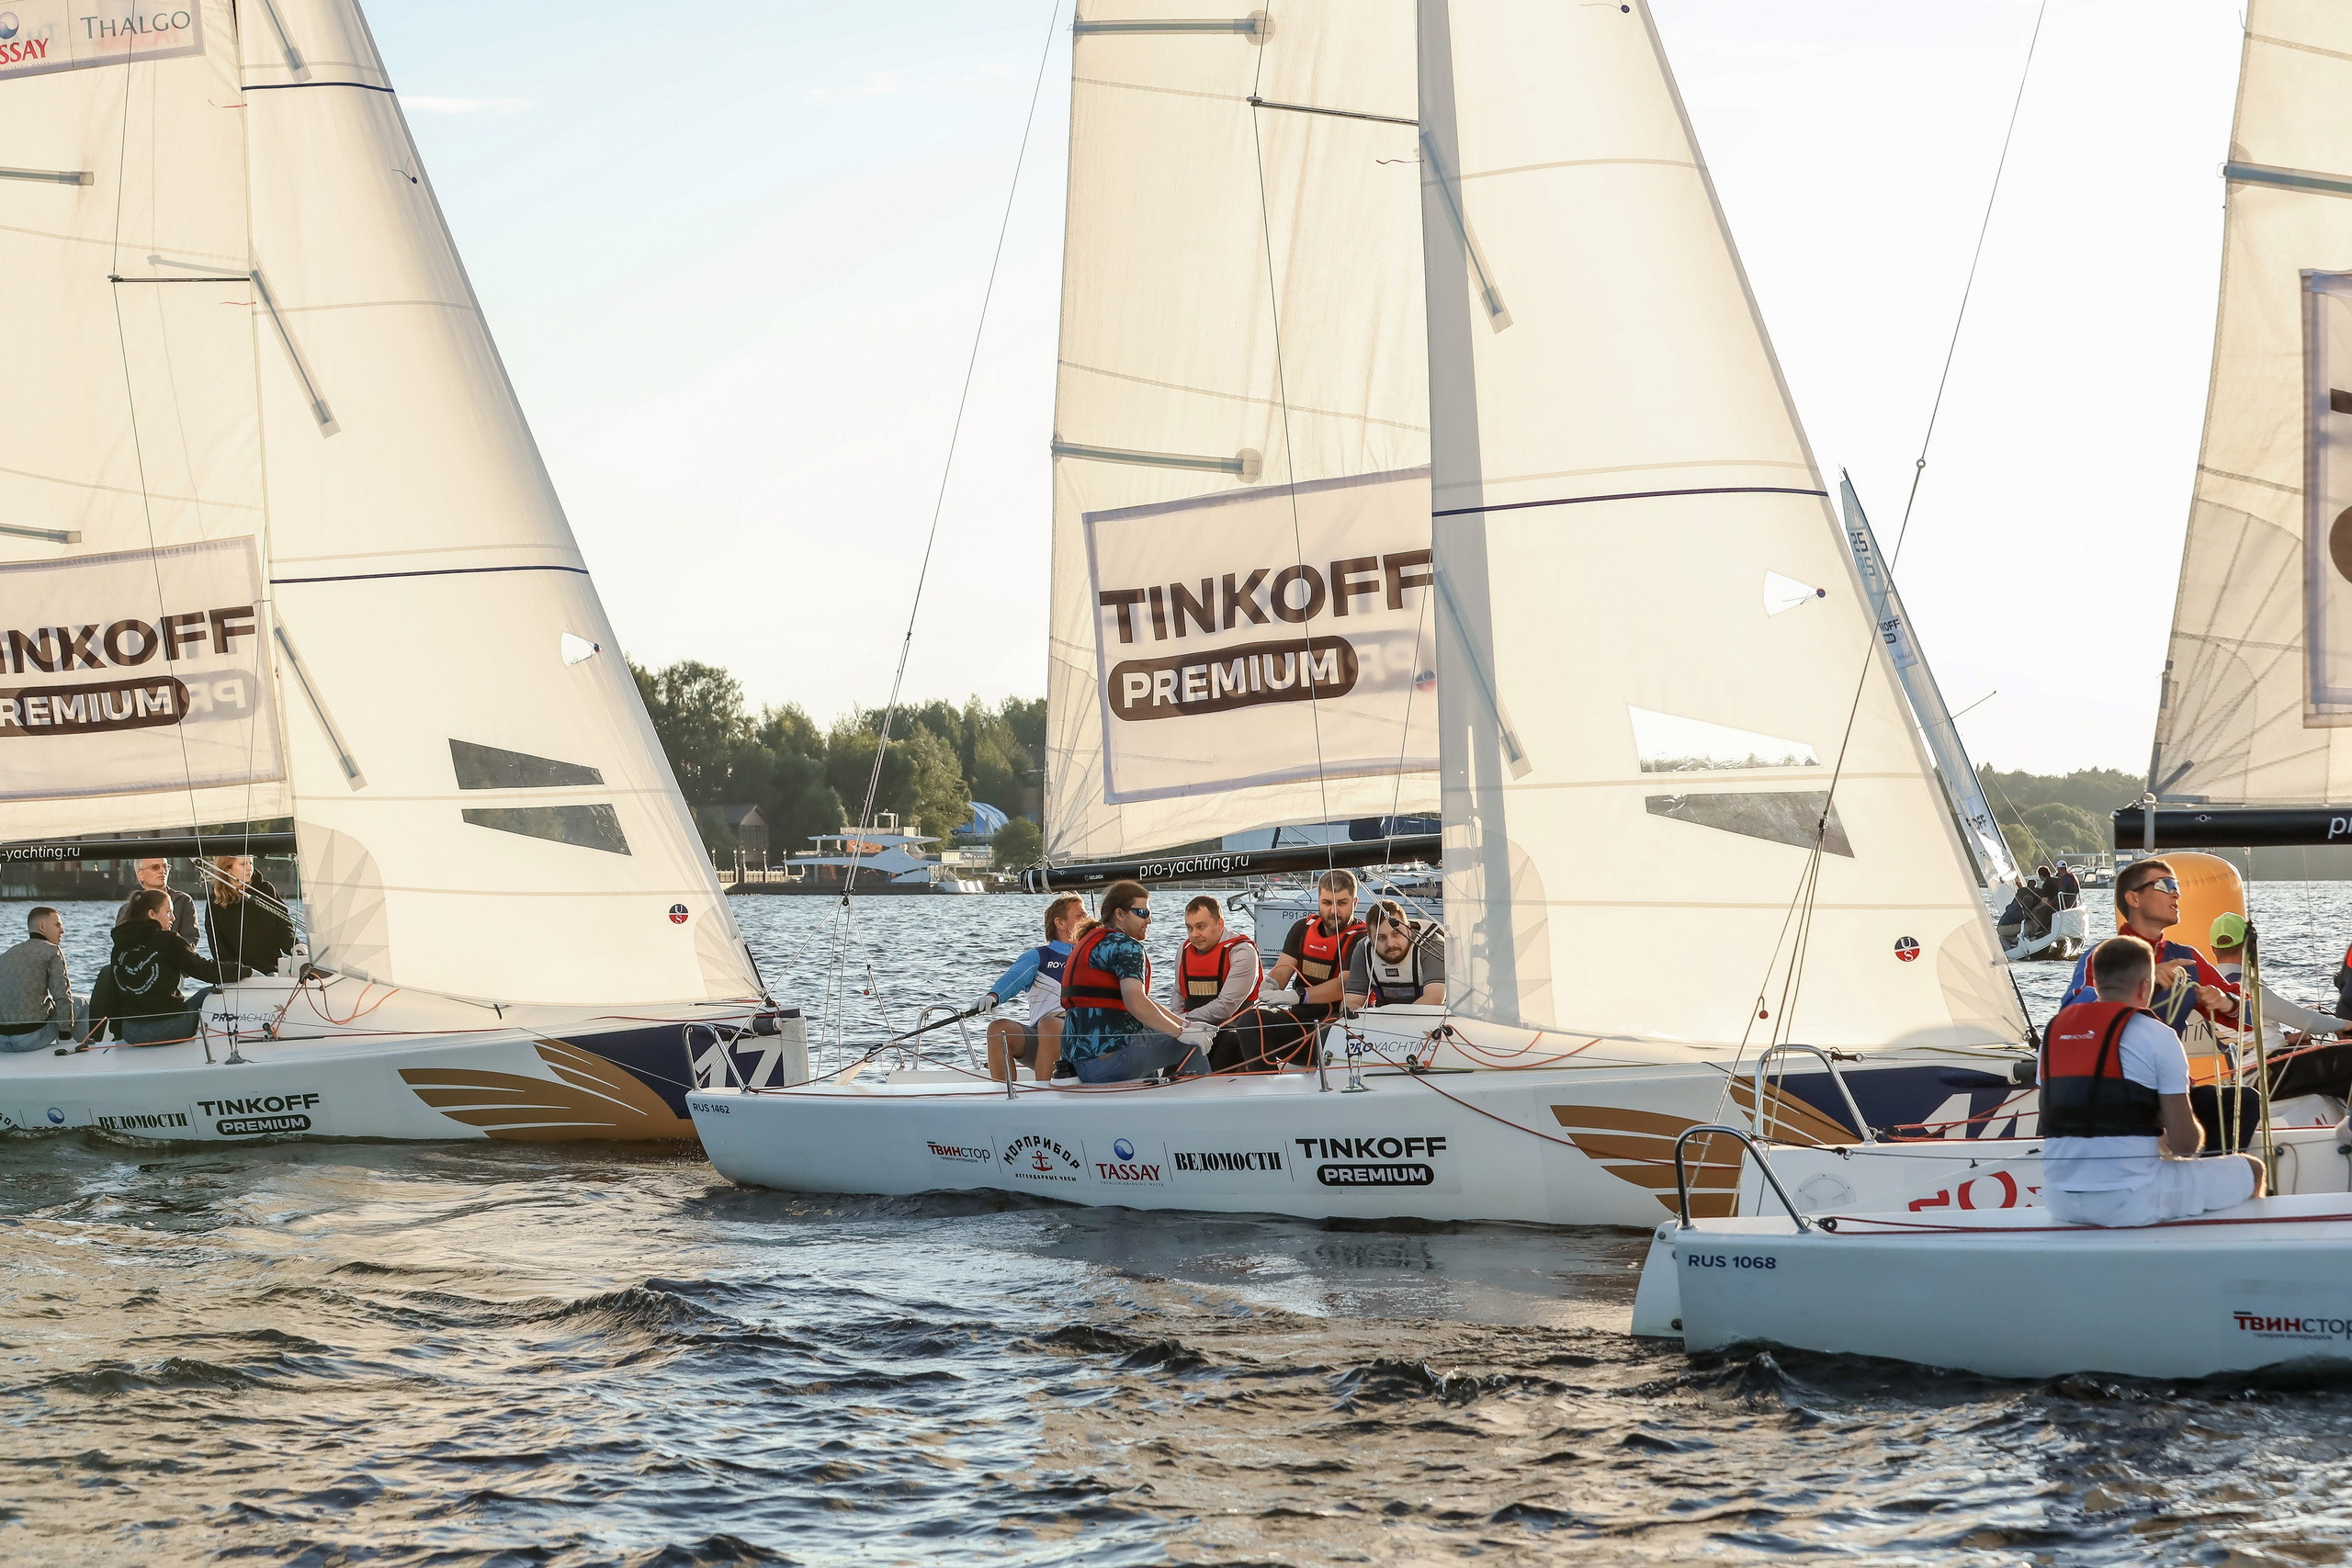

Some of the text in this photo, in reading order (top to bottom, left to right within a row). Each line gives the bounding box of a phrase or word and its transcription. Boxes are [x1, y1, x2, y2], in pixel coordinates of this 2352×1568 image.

[80, 11, 191, 39] THALGO
[1099, 549, 1434, 644] TINKOFF
[1122, 648, 1340, 709] PREMIUM
[1138, 854, 1250, 880] pro-yachting.ru
[1047, 961, 1066, 969] ROY
[197, 1093, 320, 1117] TINKOFF
[693, 1102, 730, 1114] RUS 1462
[97, 1112, 188, 1131] ВЕДОМОСТИ
[221, 1117, 306, 1133] PREMIUM
[1003, 1135, 1080, 1169] МОРПРИБОР
[1295, 1136, 1447, 1159] TINKOFF
[1095, 1163, 1160, 1181] TASSAY
[1173, 1152, 1283, 1172] ВЕДОМОСТИ
[1324, 1168, 1427, 1182] PREMIUM
[1688, 1254, 1777, 1269] RUS 1068
